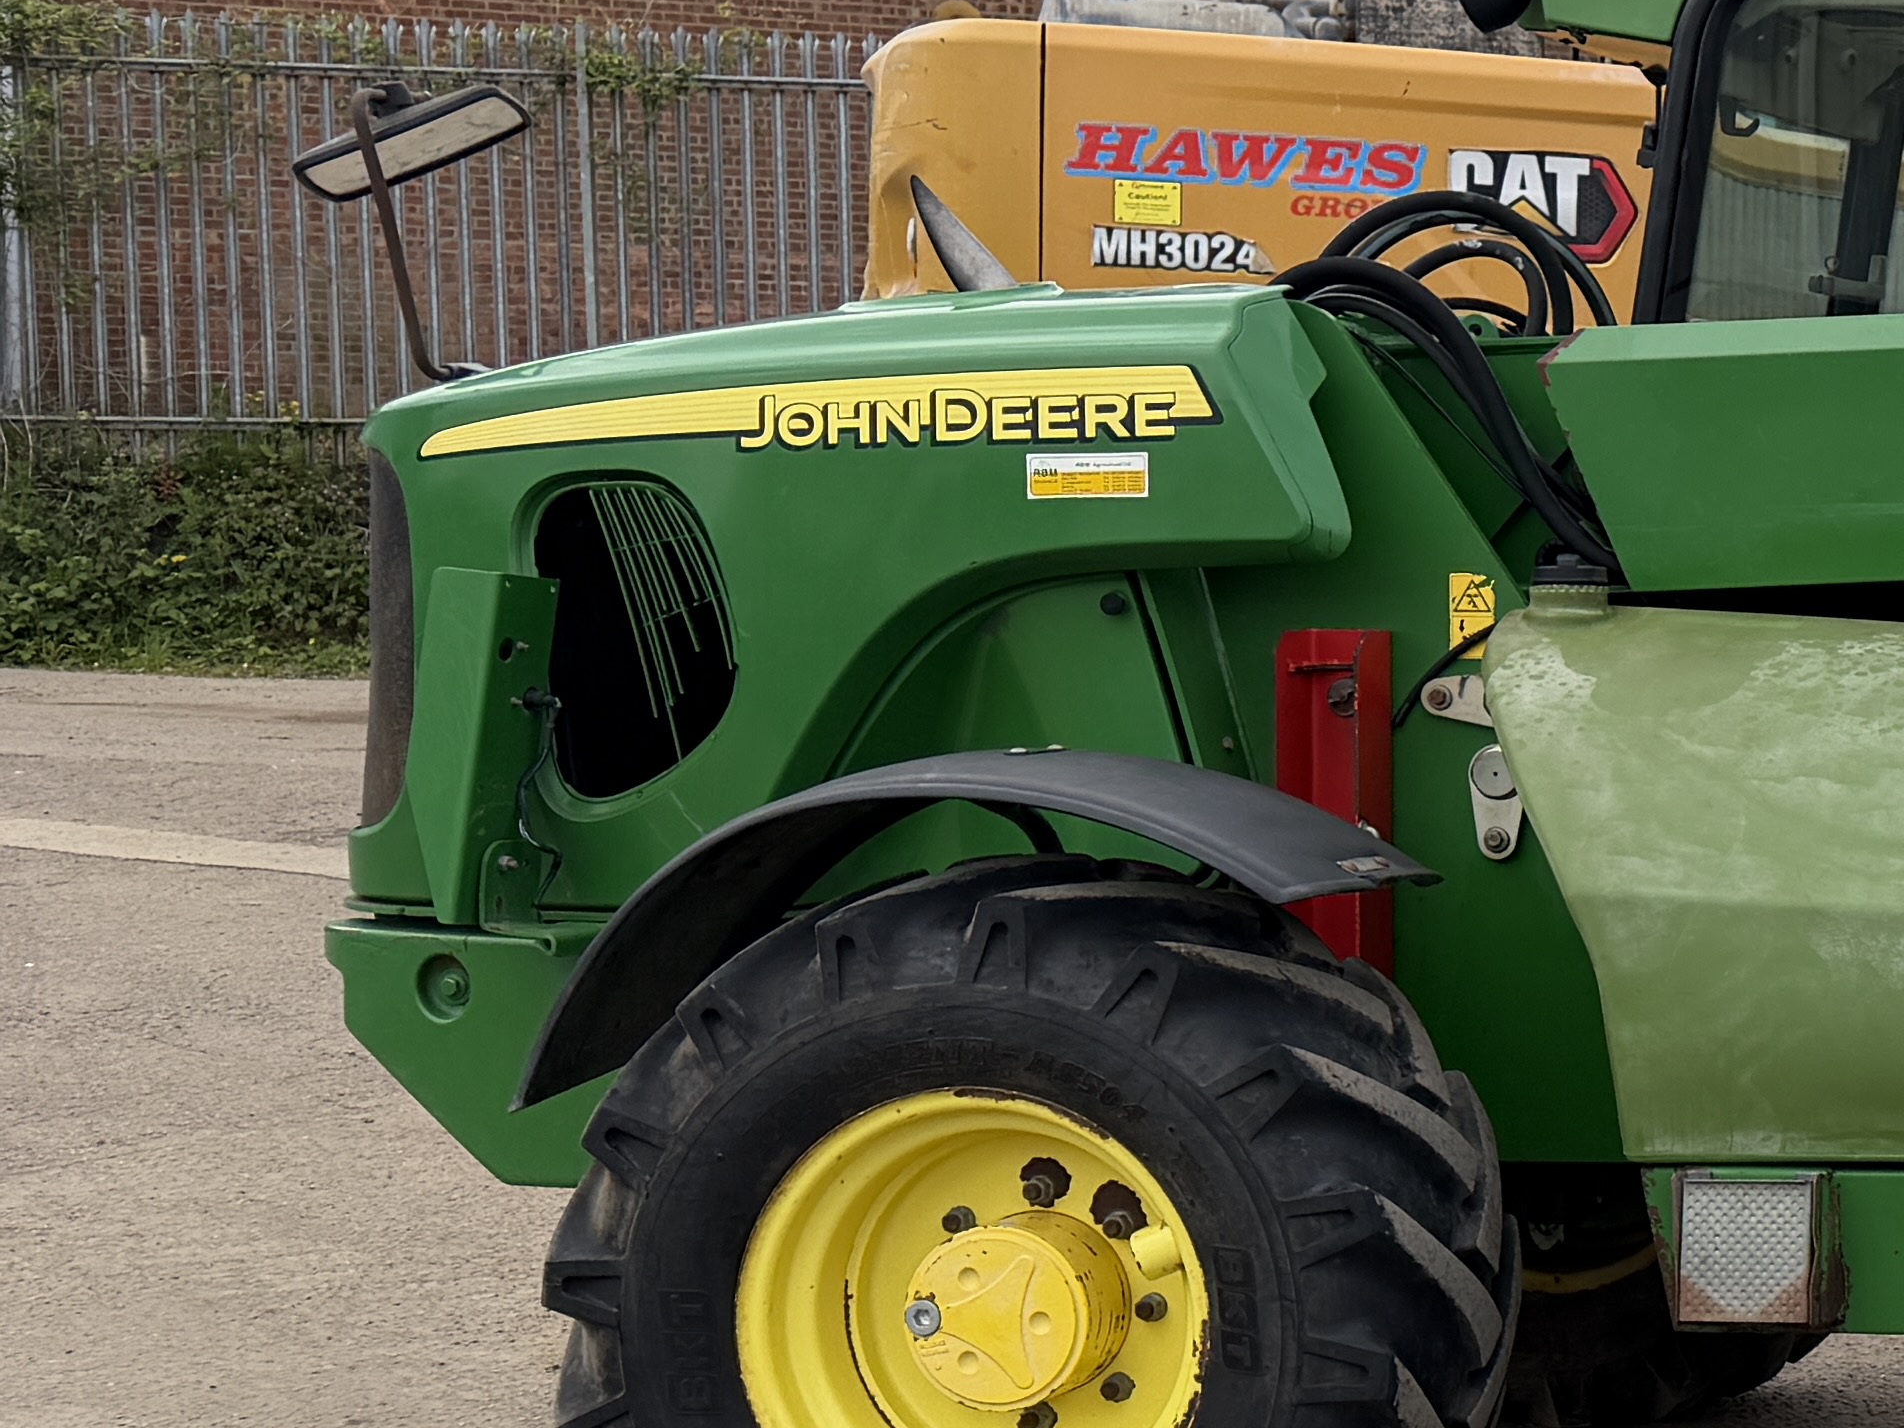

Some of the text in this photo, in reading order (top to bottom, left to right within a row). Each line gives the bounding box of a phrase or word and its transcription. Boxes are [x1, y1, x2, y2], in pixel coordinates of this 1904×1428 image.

[1064, 122, 1428, 194] HAWES
[1450, 150, 1590, 238] CAT
[1290, 195, 1386, 220] GRO
[1215, 1248, 1260, 1373] BKT
